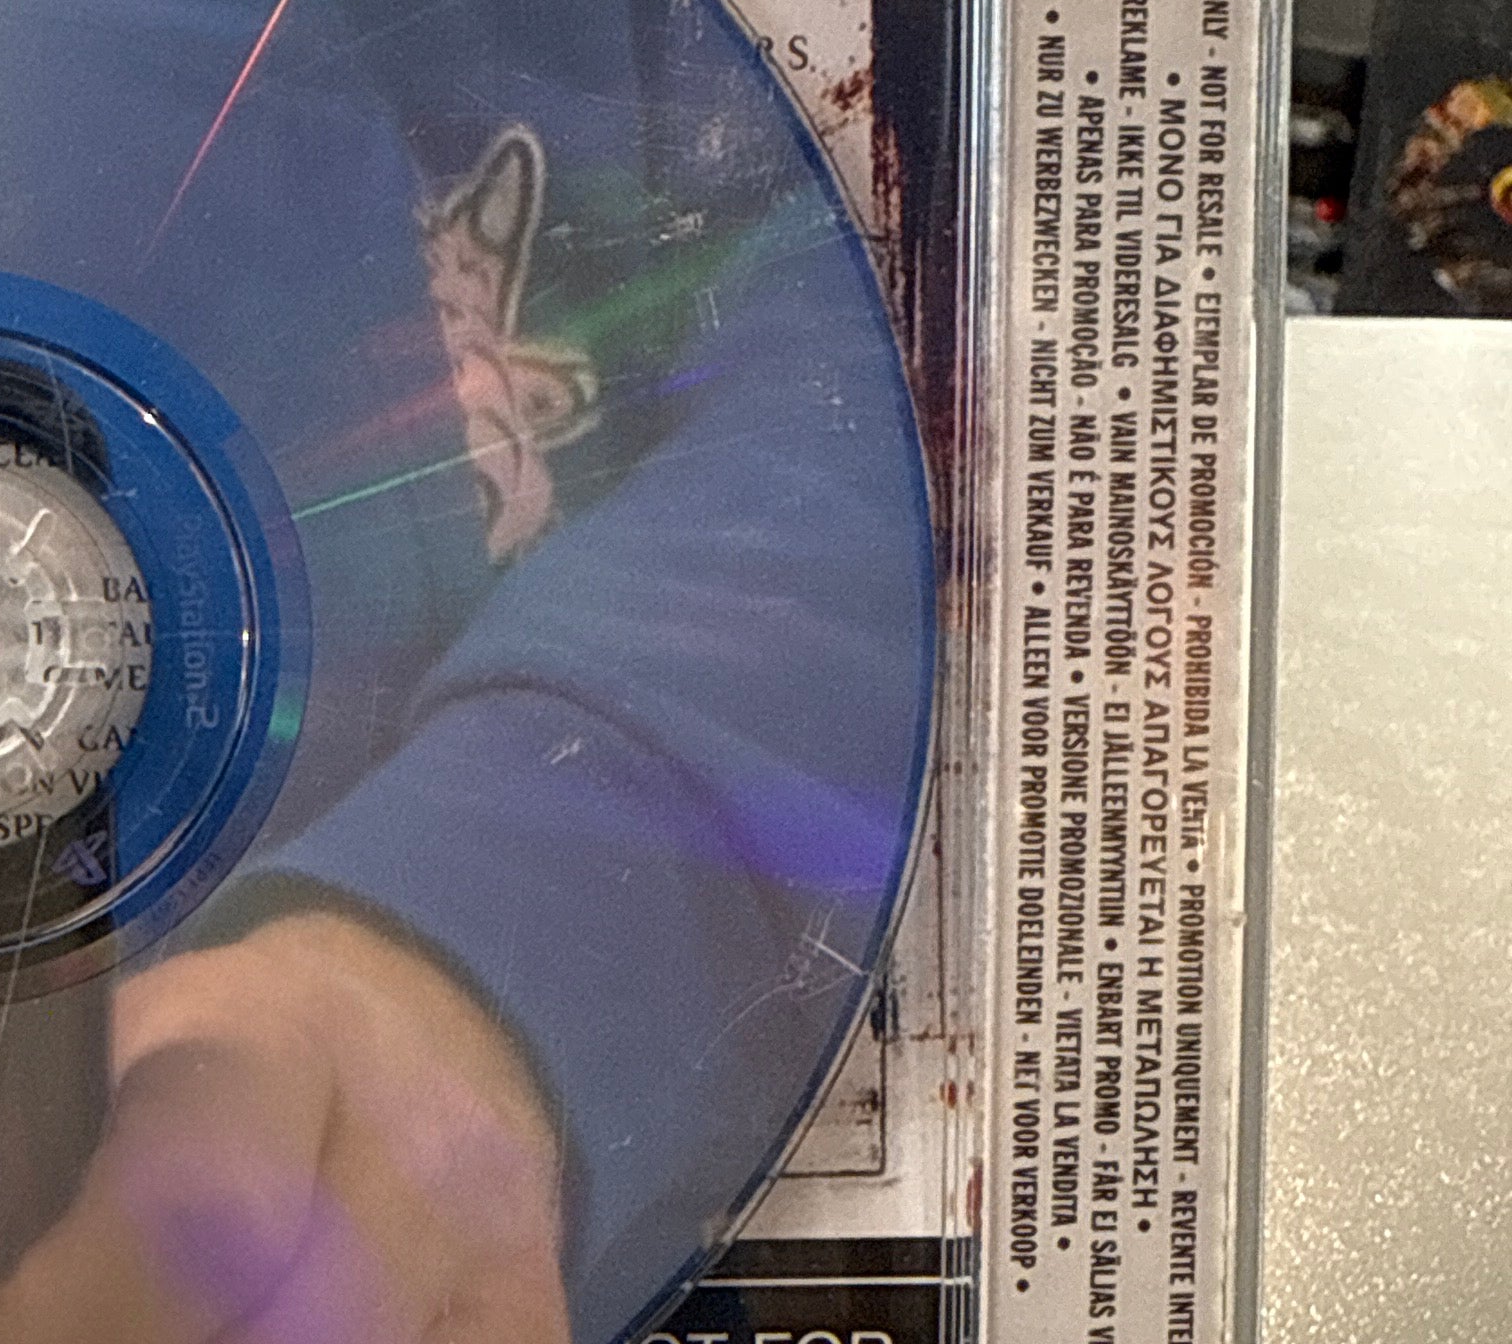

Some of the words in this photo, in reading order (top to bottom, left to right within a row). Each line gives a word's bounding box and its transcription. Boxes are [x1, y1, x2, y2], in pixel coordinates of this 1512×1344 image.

[1037, 35, 1065, 82] NUR
[1200, 66, 1227, 113] NOT
[1036, 90, 1065, 118] ZU
[1076, 95, 1105, 184] APENAS
[1199, 120, 1226, 164] FOR
[1117, 125, 1145, 179] IKKE
[1032, 127, 1063, 312] WERBEZWECKEN
[1075, 193, 1102, 251] PARA
[1116, 186, 1143, 222] TIL
[1196, 173, 1225, 257] RESALE
[1067, 261, 1102, 388] PROMOÇÃO
[1112, 230, 1142, 368] VIDERESALG
[1029, 339, 1057, 408] NICHT
[1192, 292, 1222, 406] EJEMPLAR
[1028, 415, 1056, 462] ZUM
[1069, 414, 1100, 461] NÃO
[1110, 411, 1137, 463] VAIN
[1191, 415, 1218, 444] DE
[1068, 470, 1101, 483] É
[1026, 470, 1054, 573] VERKAUF
[1068, 492, 1094, 550] PARA
[1187, 453, 1220, 588] PROMOCIÓN
[1064, 559, 1093, 660] REVENDA
[1104, 472, 1138, 675] MAINOSKÄYTTÖÖN
[1023, 606, 1051, 689] ALLEEN
[1184, 615, 1212, 737] PROHIBIDA
[1022, 696, 1049, 758] VOOR
[1061, 693, 1090, 802] VERSIONE
[1103, 702, 1131, 722] EI
[1182, 746, 1210, 773] LA
[1018, 766, 1047, 879] PROMOTIE
[1099, 731, 1134, 927] JÄLLEENMYYNTIIN
[1057, 812, 1087, 984] PROMOZIONALE
[1015, 887, 1044, 1024] DOELEINDEN
[1177, 884, 1205, 1014] PROMOTION
[1096, 962, 1124, 1047] ENBART
[1054, 1008, 1082, 1093] VIETATA
[1012, 1099, 1040, 1160] VOOR
[1054, 1101, 1080, 1128] LA
[1094, 1056, 1122, 1135] PROMO
[1173, 1023, 1202, 1165] UNIQUEMENT
[1010, 1166, 1038, 1270] VERKOOP
[1051, 1135, 1079, 1227] VENDITA
[1091, 1210, 1118, 1232] EJ
[1093, 1160, 1124, 1202] FÅR
[1088, 1240, 1122, 1318] SÄLJAS
[1169, 1190, 1198, 1285] REVENTE
